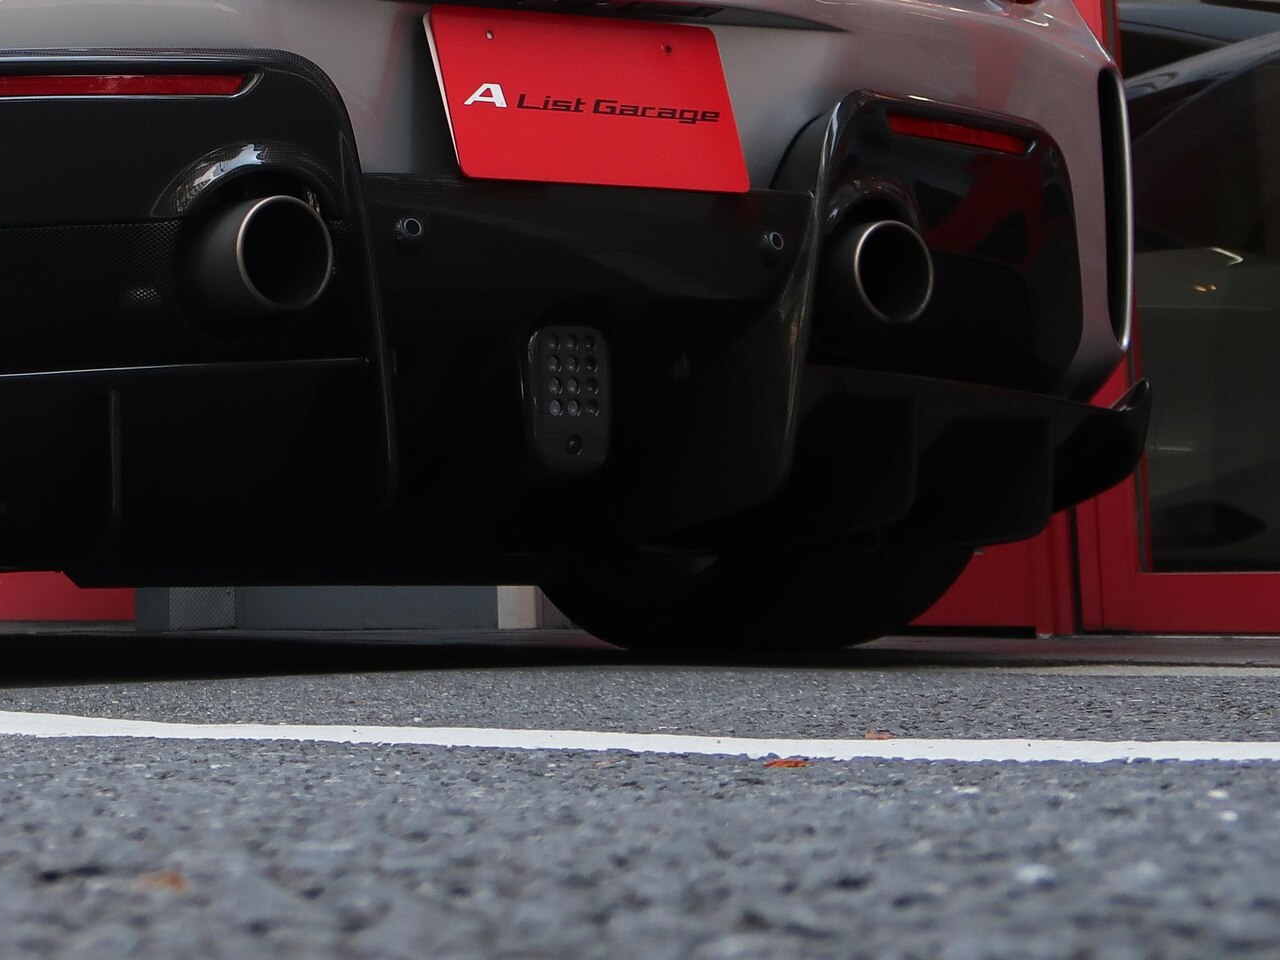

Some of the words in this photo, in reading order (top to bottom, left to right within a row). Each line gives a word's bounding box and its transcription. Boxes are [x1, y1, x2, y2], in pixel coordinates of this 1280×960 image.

[463, 82, 508, 108] A
[517, 93, 586, 113] List
[592, 98, 721, 125] Garage
